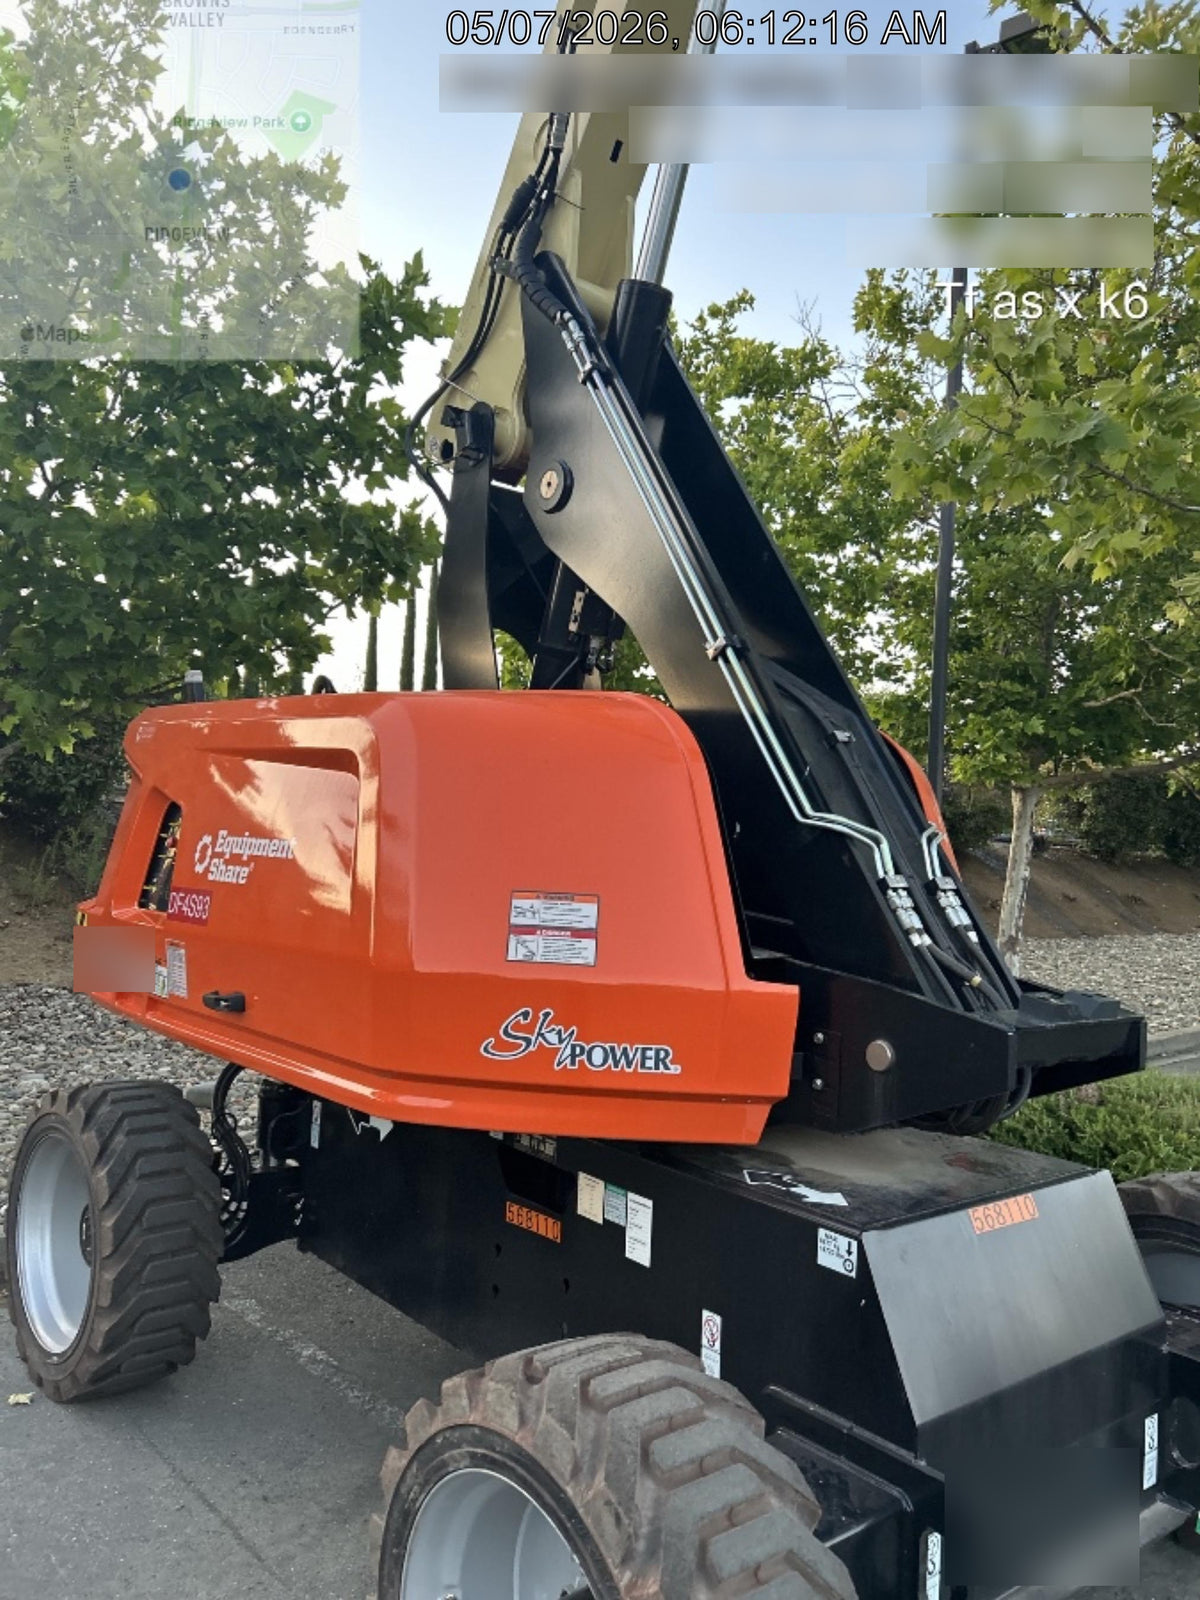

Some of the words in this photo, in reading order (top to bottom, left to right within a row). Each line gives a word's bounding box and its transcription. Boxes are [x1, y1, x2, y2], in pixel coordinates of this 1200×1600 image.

[215, 830, 297, 860] Equipment
[208, 858, 250, 885] Share
[507, 1202, 560, 1240] 568110
[971, 1195, 1036, 1231] 568110
